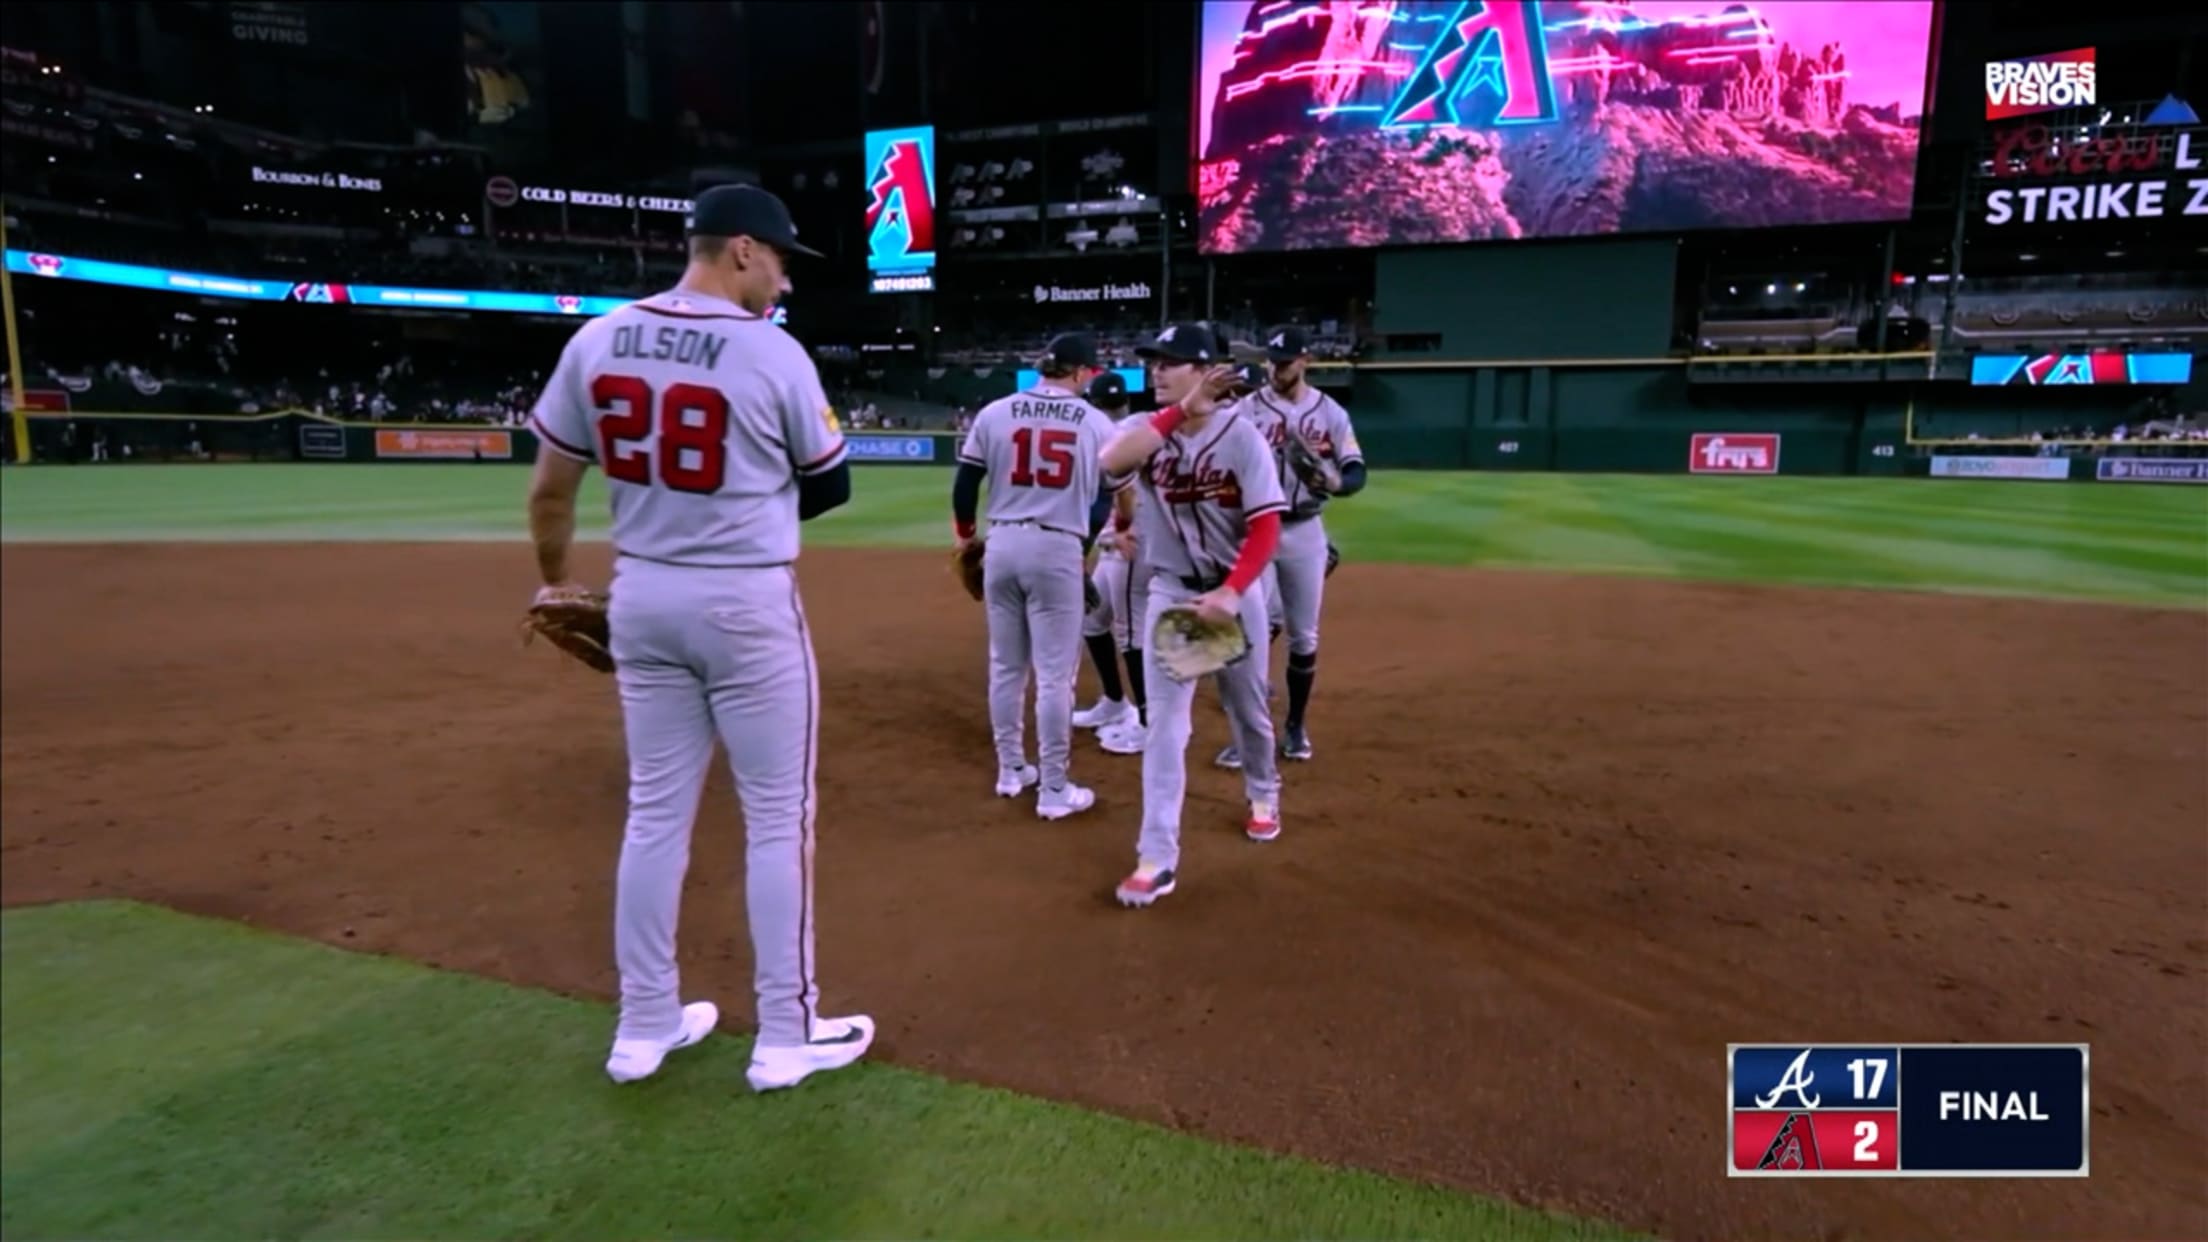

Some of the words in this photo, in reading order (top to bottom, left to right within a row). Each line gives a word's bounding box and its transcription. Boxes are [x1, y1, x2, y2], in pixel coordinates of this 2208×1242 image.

[232, 24, 308, 46] GIVING
[322, 172, 335, 188] &
[521, 186, 567, 203] COLD
[569, 190, 624, 208] BEERS
[1985, 180, 2168, 225] STRIKE
[1050, 286, 1100, 302] Banner
[1103, 282, 1151, 299] Health
[612, 324, 728, 371] OLSON
[1011, 400, 1086, 426] FARMER
[591, 373, 730, 496] 28
[1010, 427, 1078, 490] 15
[1872, 445, 1894, 457] 413
[2130, 462, 2194, 477] Banner
